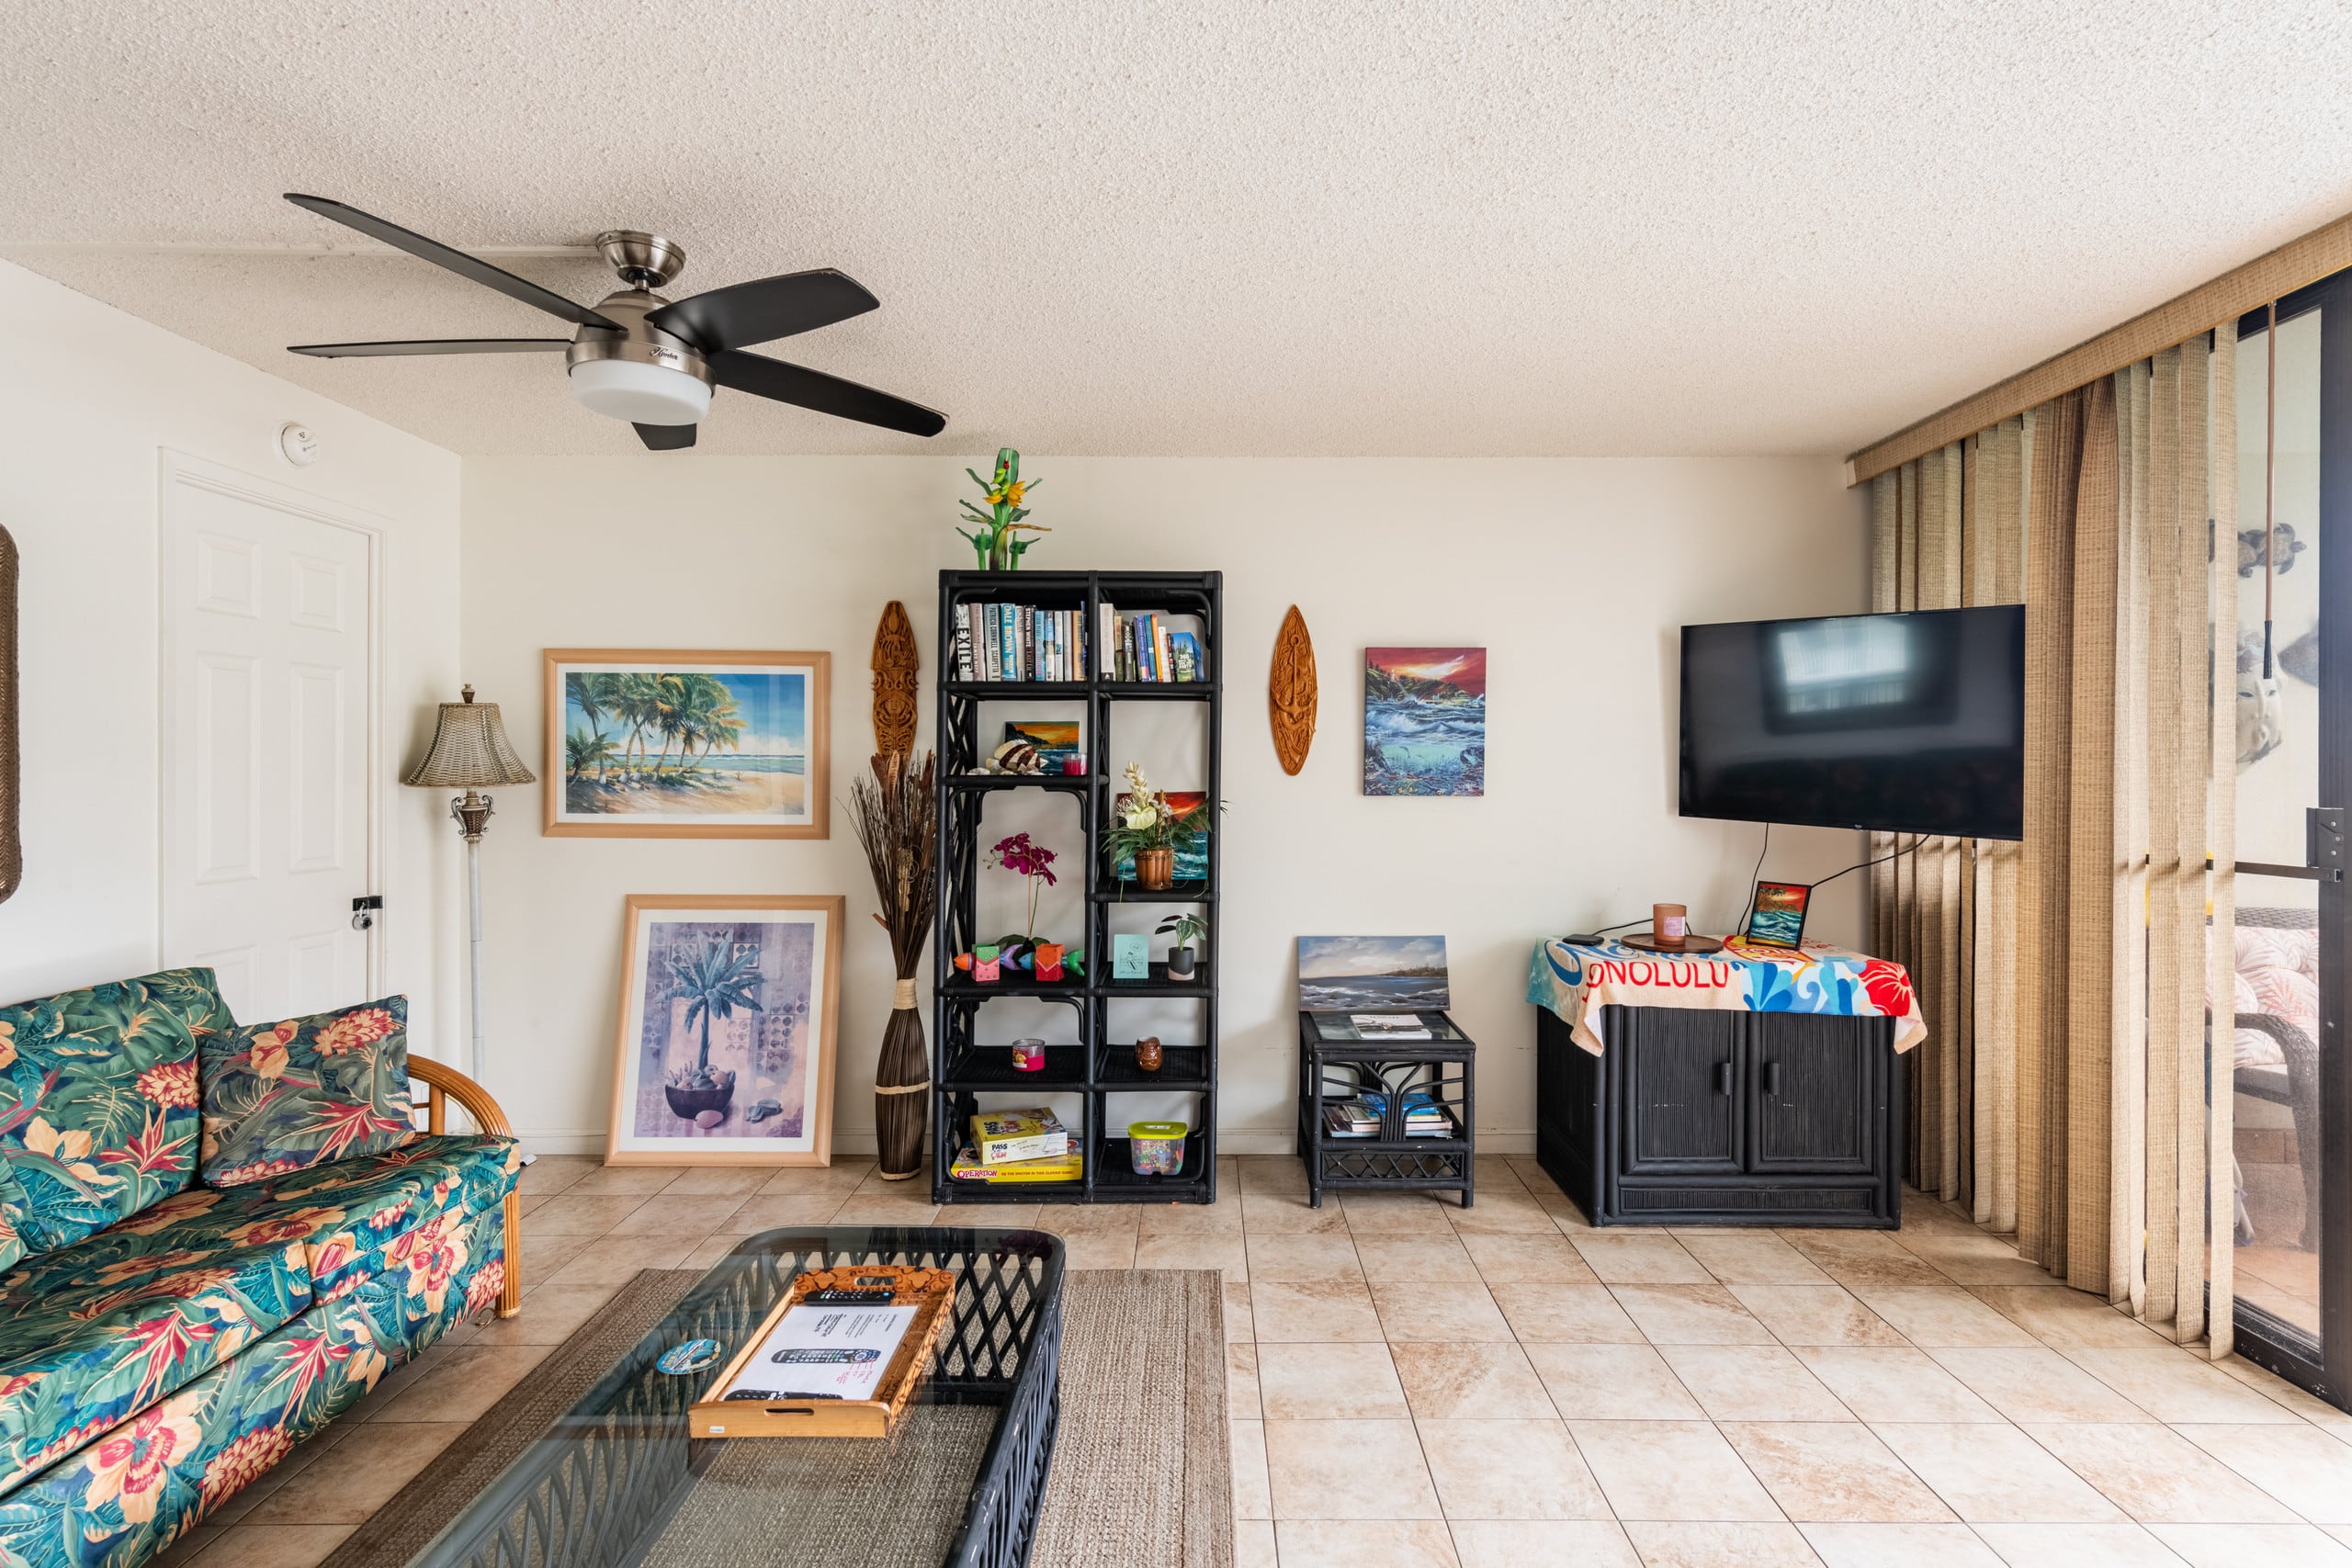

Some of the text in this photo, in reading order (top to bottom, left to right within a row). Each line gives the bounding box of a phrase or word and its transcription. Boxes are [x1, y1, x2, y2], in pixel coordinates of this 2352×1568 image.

[1003, 605, 1012, 624] DALE
[956, 627, 972, 670] EXILE
[989, 607, 1000, 672] PATRICIA CORNWELL SCARPETTA
[1003, 626, 1013, 654] BROWN
[1584, 960, 1729, 990] ONOLULU
[991, 1143, 1008, 1151] PASS
[956, 1169, 998, 1179] OPERATION
